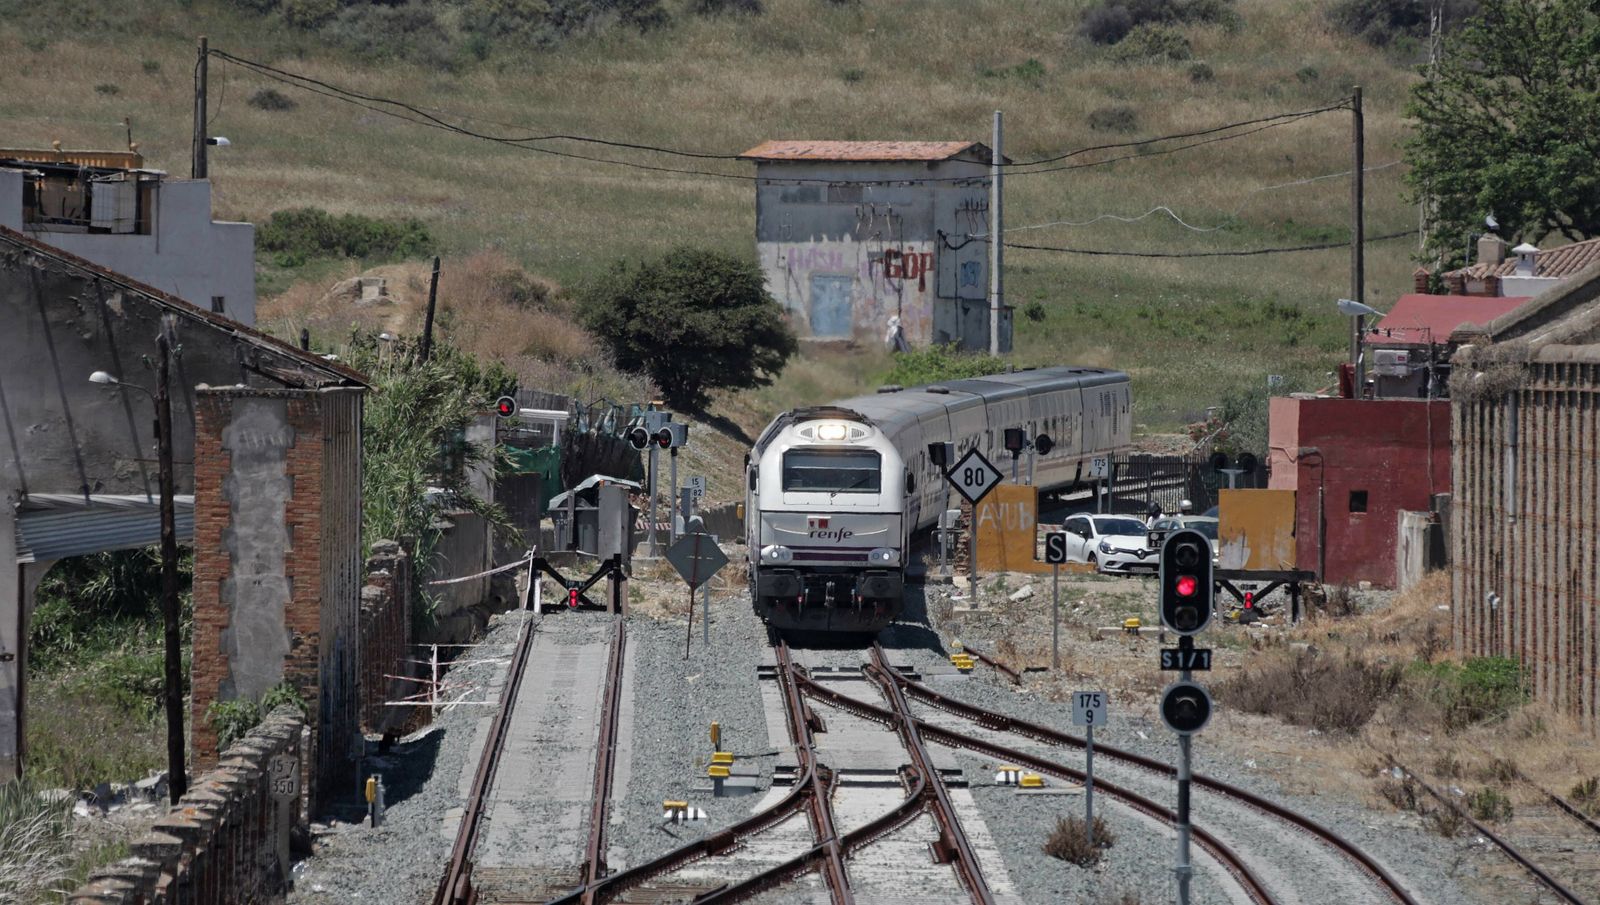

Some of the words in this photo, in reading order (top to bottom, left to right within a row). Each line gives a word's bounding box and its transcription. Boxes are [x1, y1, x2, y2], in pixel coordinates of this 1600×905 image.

[963, 467, 985, 487] 80
[809, 527, 853, 543] renfe
[1049, 534, 1064, 562] S
[1079, 694, 1101, 708] 175
[1085, 709, 1094, 724] 9
